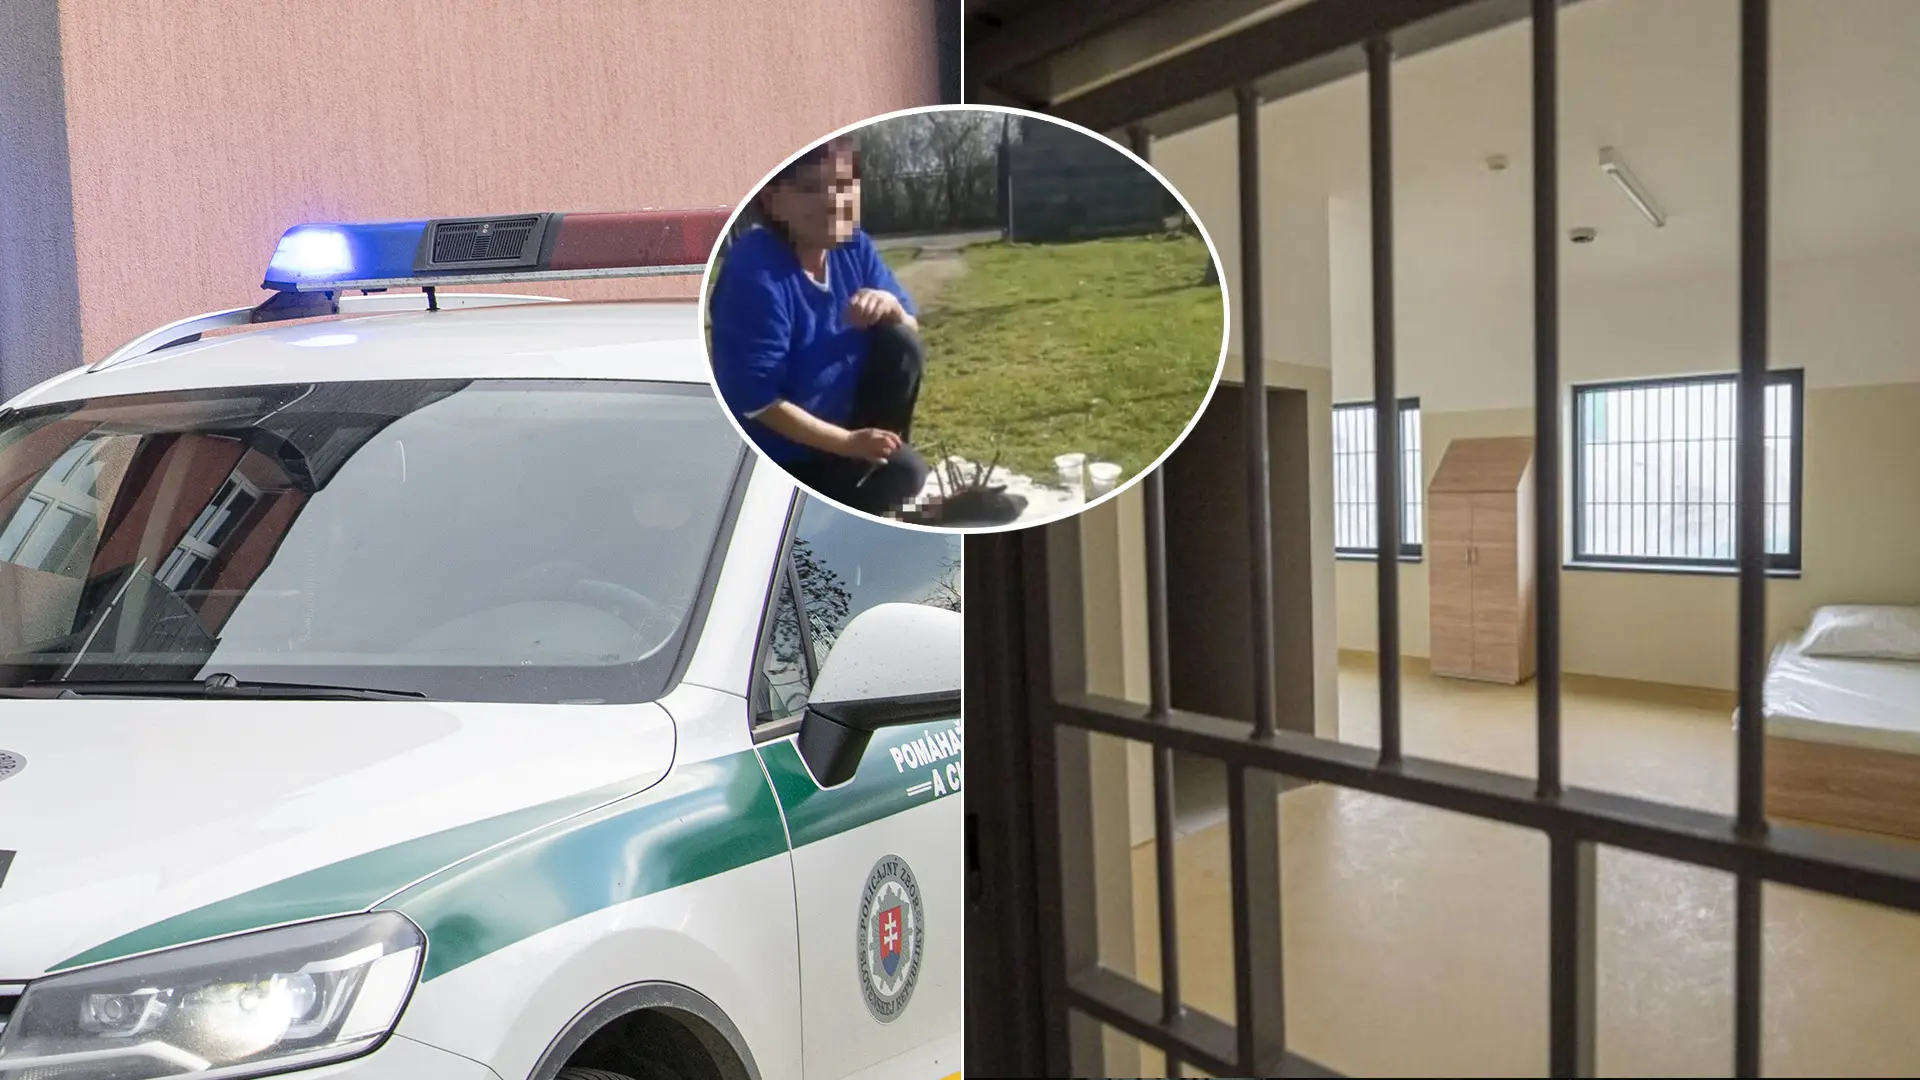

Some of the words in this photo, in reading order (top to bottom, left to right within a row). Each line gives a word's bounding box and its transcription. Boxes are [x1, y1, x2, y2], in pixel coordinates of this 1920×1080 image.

[932, 768, 947, 797] A
[946, 761, 961, 791] C
[860, 857, 899, 932] POLICAJNÝ
[900, 867, 920, 911] ZBOR
[860, 950, 895, 1015] SLOVENSKEJ
[895, 925, 922, 1011] REPUBLIKY
